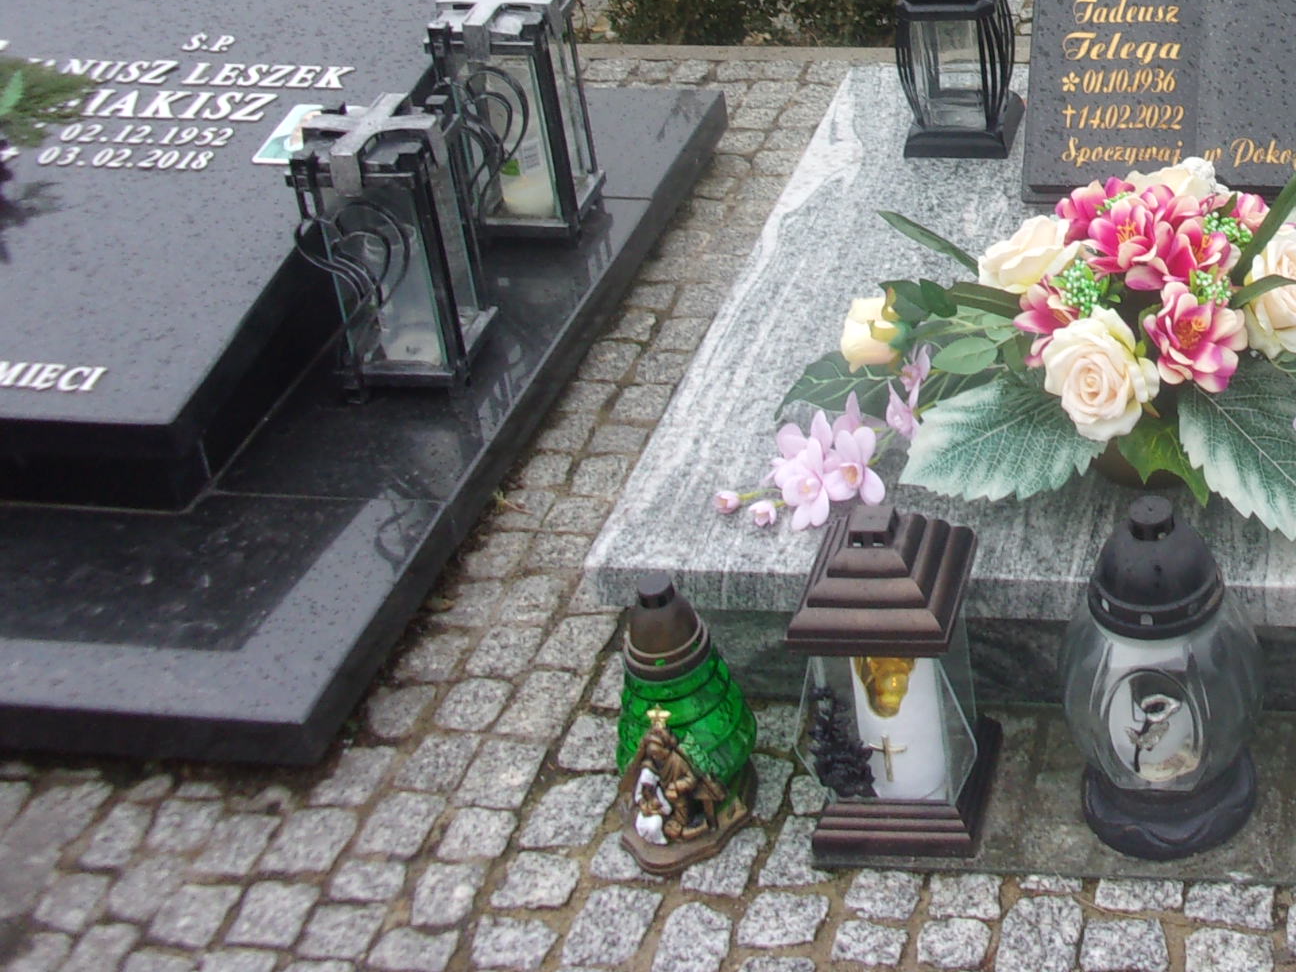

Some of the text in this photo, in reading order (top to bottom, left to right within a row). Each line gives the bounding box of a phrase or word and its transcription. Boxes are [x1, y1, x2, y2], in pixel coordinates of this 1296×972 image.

[1062, 31, 1182, 65] Telega
[28, 57, 354, 89] NUSZ LESZEK
[1083, 68, 1176, 94] 01.10.1936
[1079, 104, 1184, 130] 14.02.2022
[60, 123, 233, 146] 02.12.1952
[38, 146, 214, 170] 03.02.2018
[1062, 136, 1184, 168] Spoczywaj
